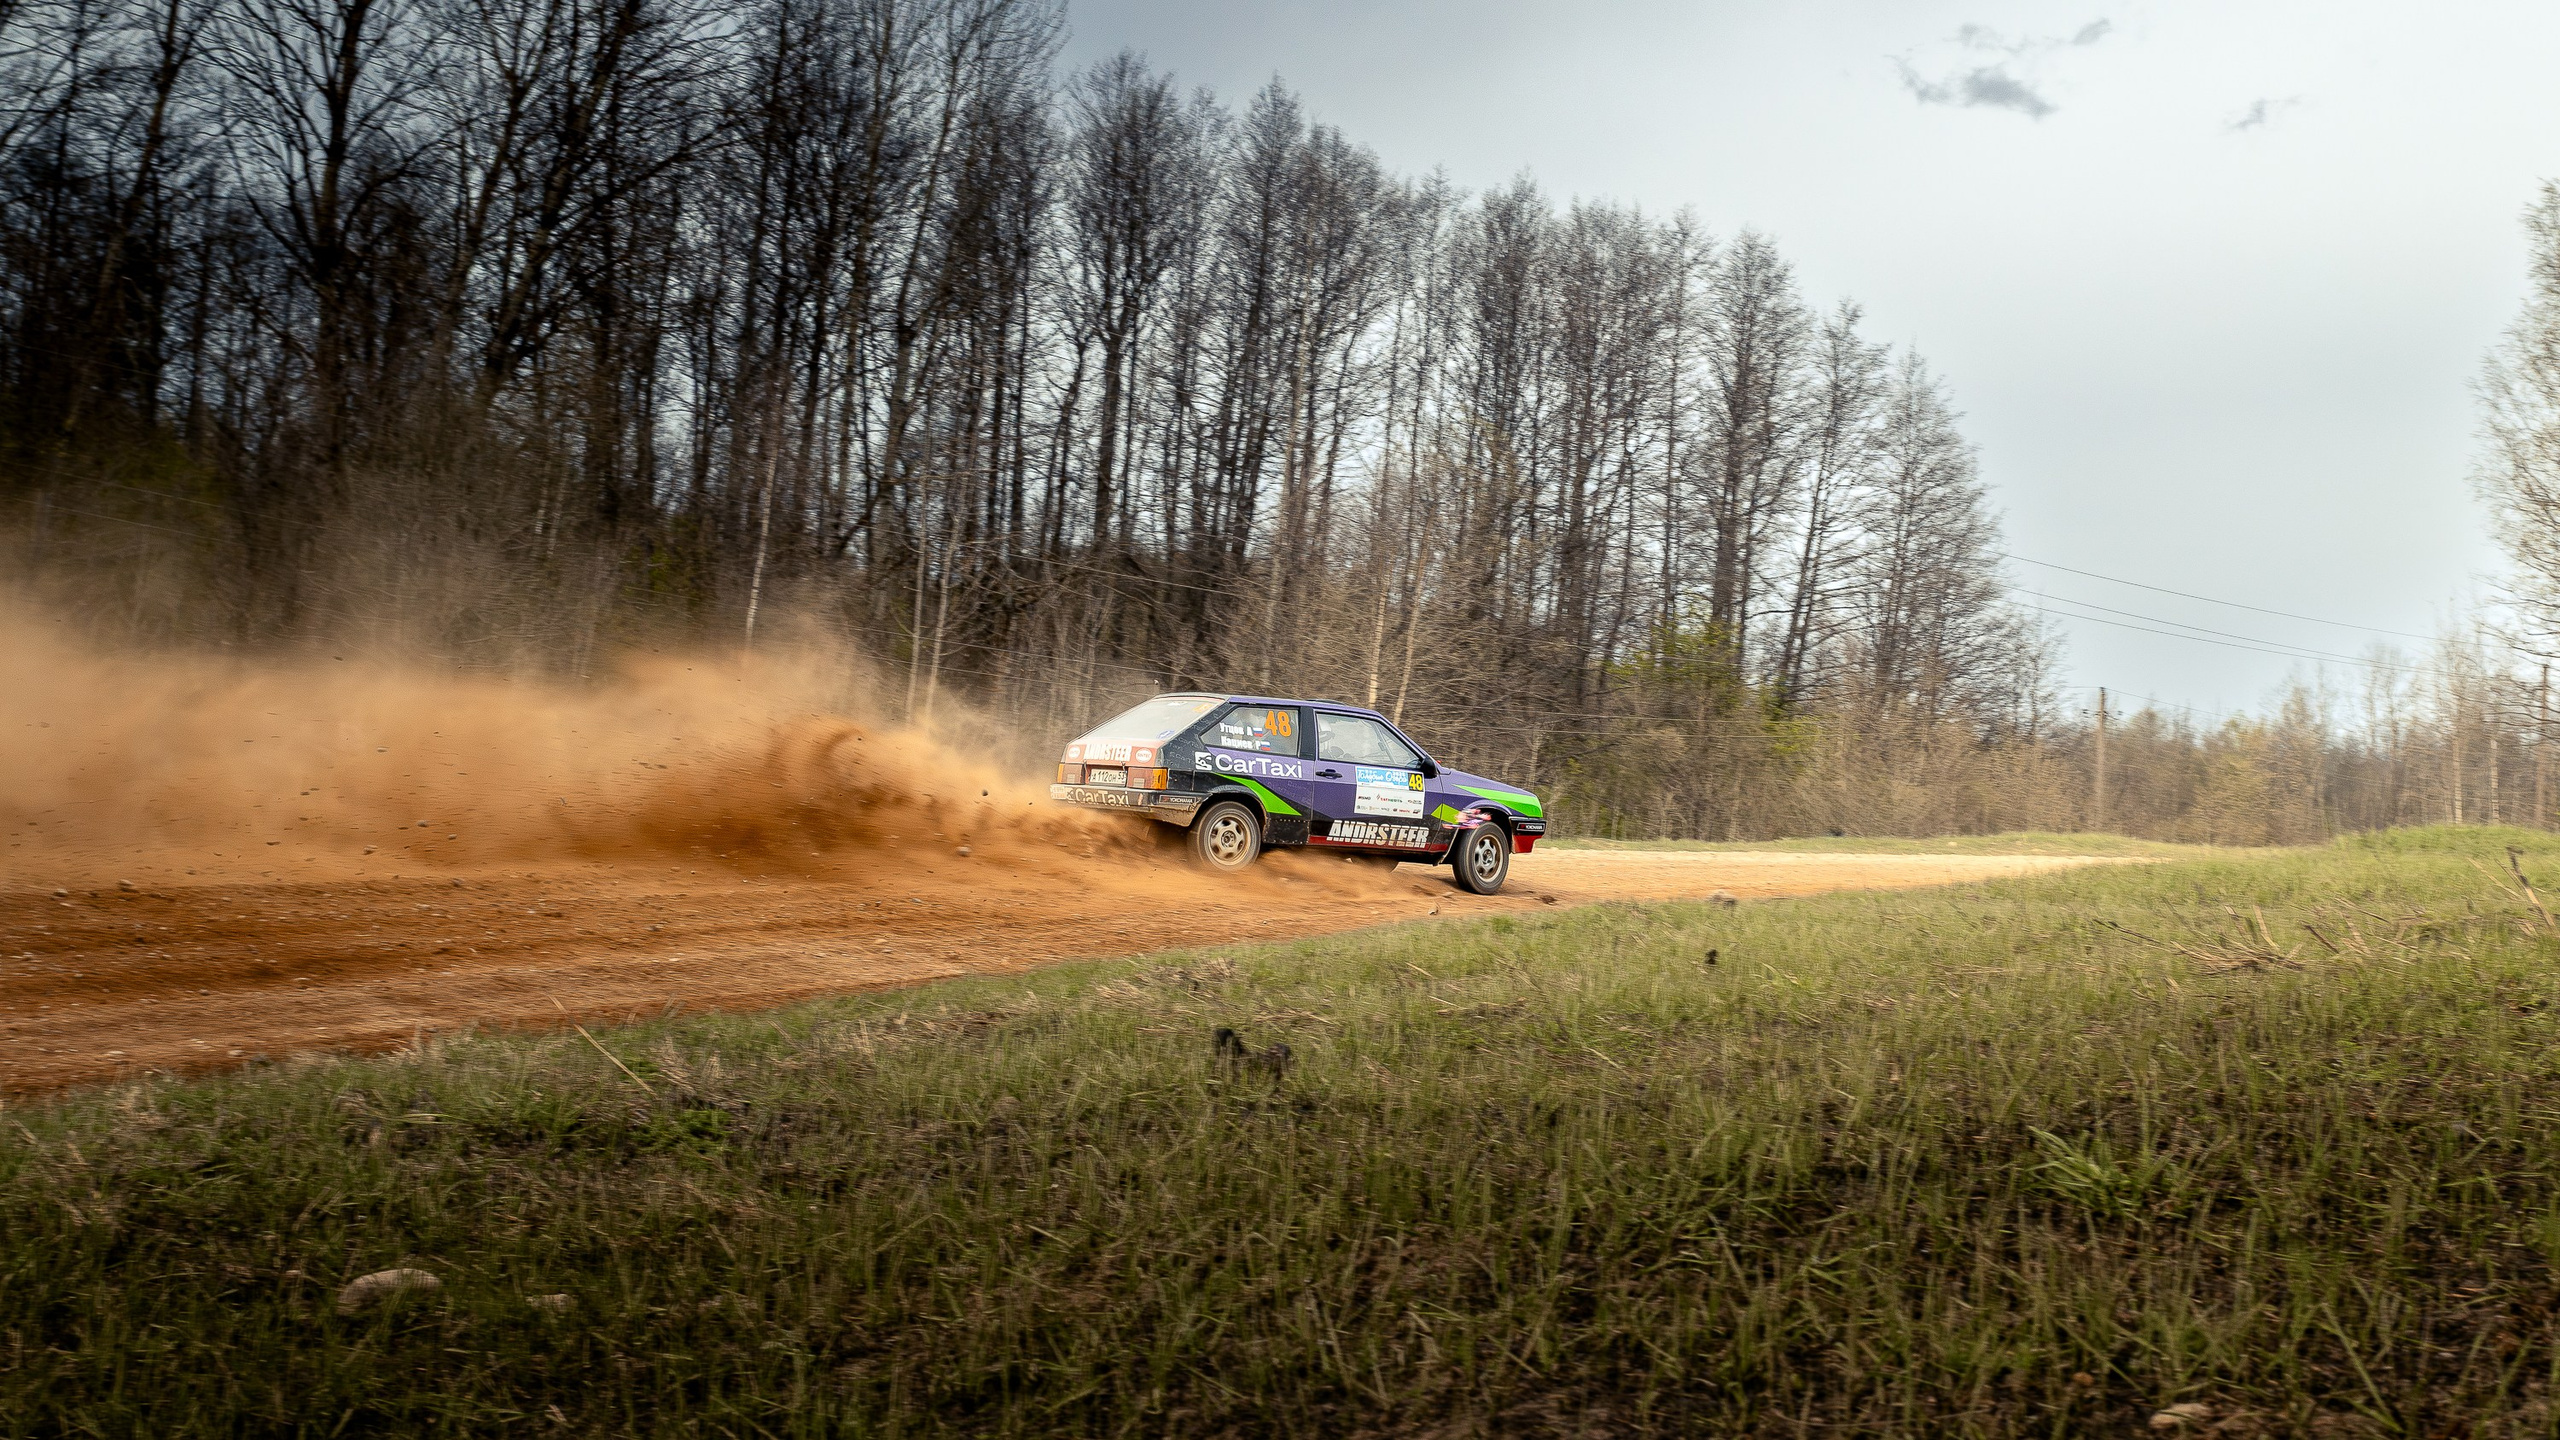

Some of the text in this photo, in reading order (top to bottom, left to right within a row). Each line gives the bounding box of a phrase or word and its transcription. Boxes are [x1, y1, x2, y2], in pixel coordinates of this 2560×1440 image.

[1264, 710, 1292, 737] 48
[1215, 753, 1302, 778] CarTaxi
[1409, 774, 1423, 791] 48
[1075, 788, 1131, 808] CarTaxi
[1326, 819, 1429, 848] ANDRSTEER
